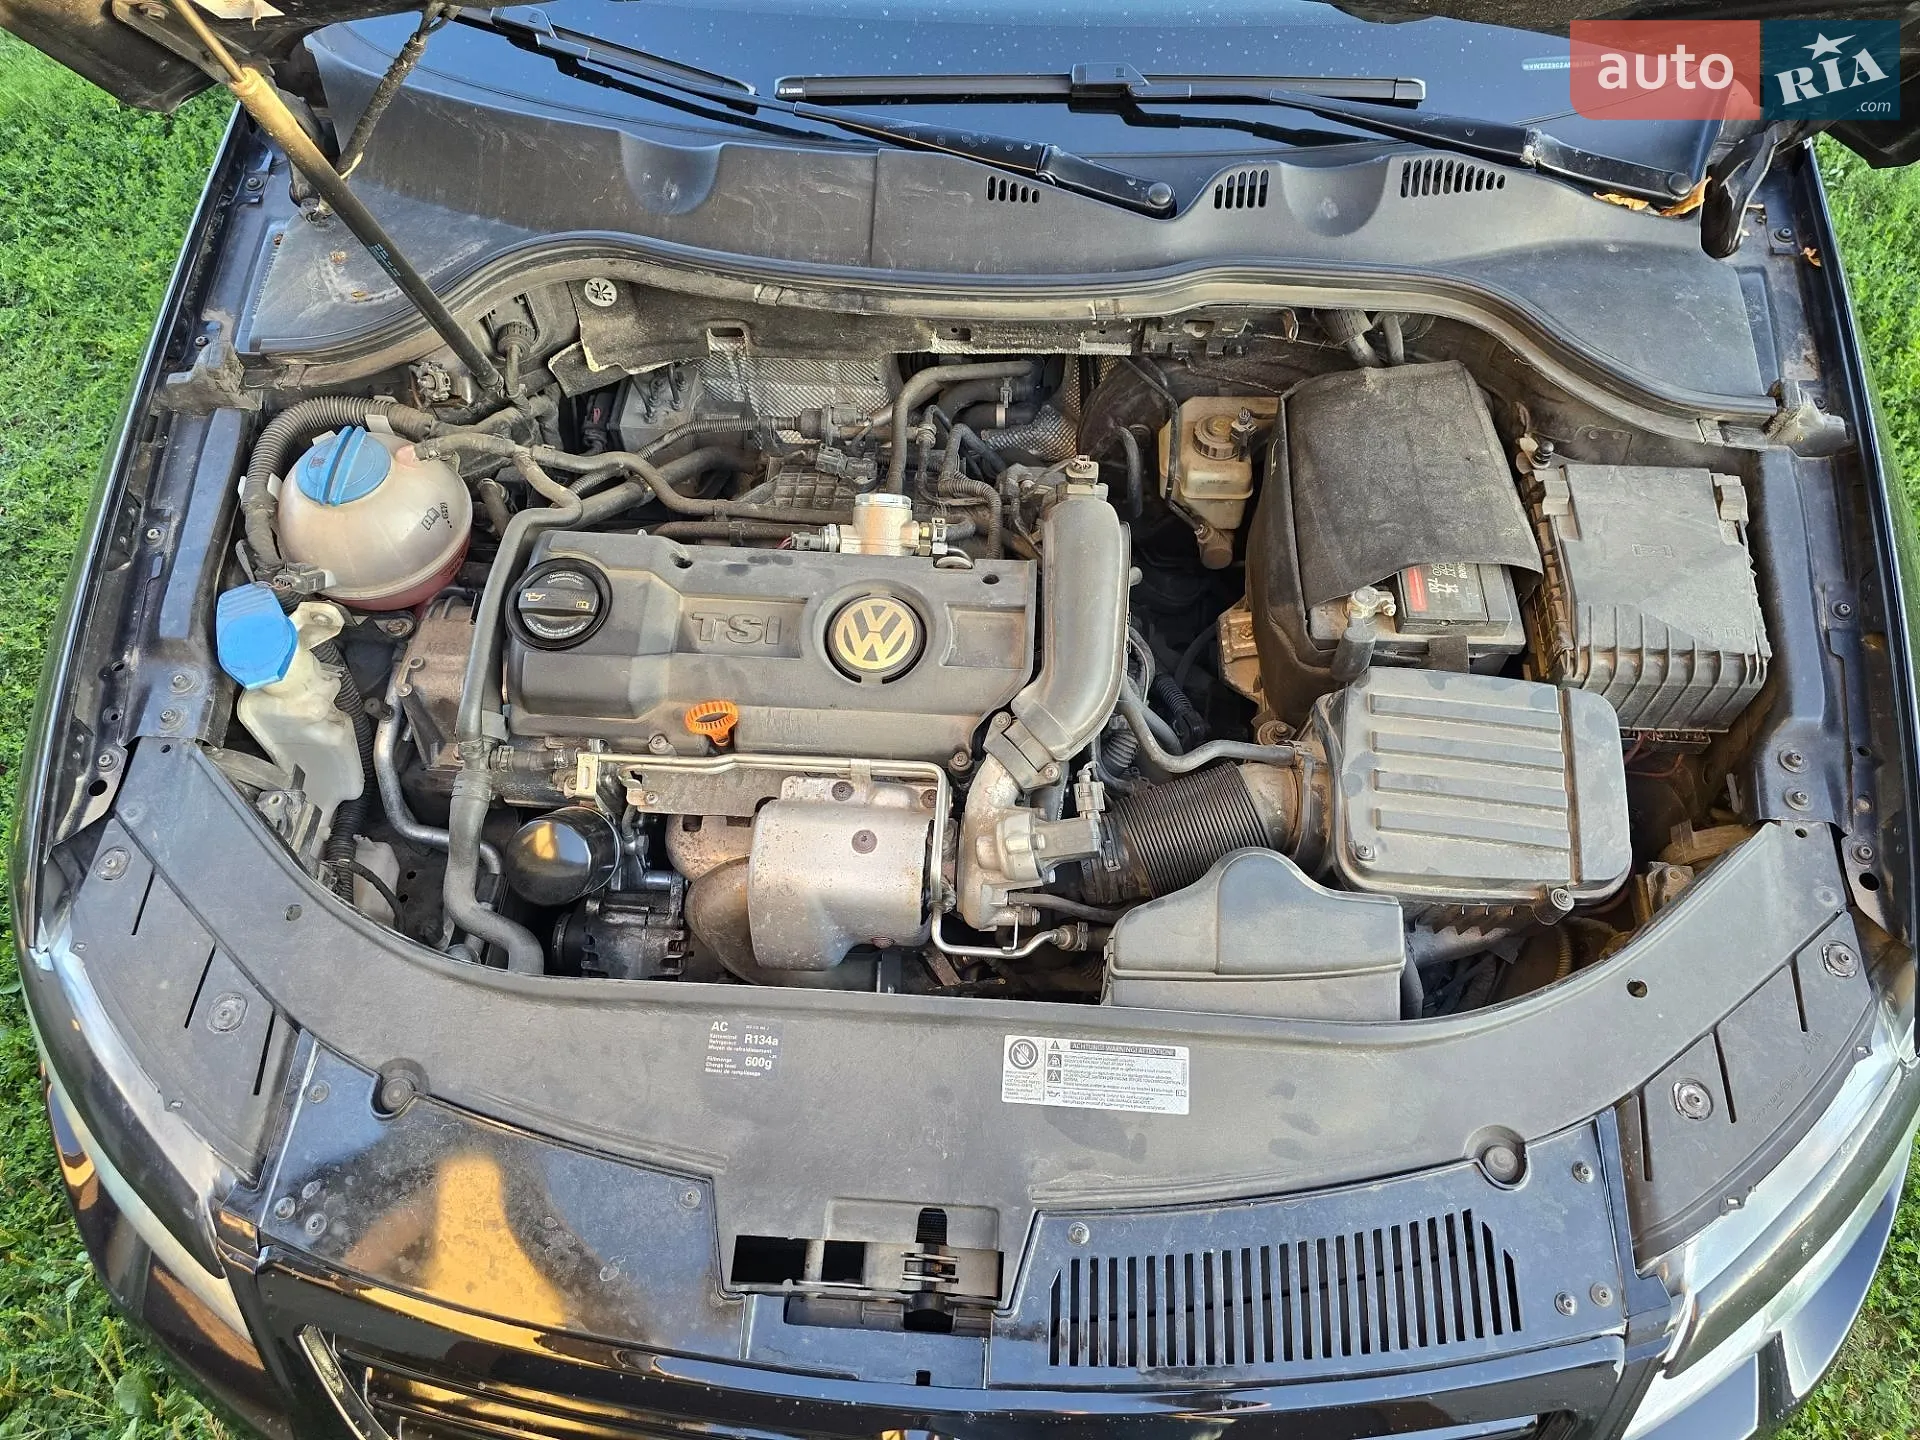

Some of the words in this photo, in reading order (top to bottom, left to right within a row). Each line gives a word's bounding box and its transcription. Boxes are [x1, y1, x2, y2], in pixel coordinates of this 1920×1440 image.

[692, 611, 782, 645] TSI
[711, 1021, 729, 1032] AC
[744, 1033, 779, 1046] R134a
[745, 1056, 773, 1070] 600g
